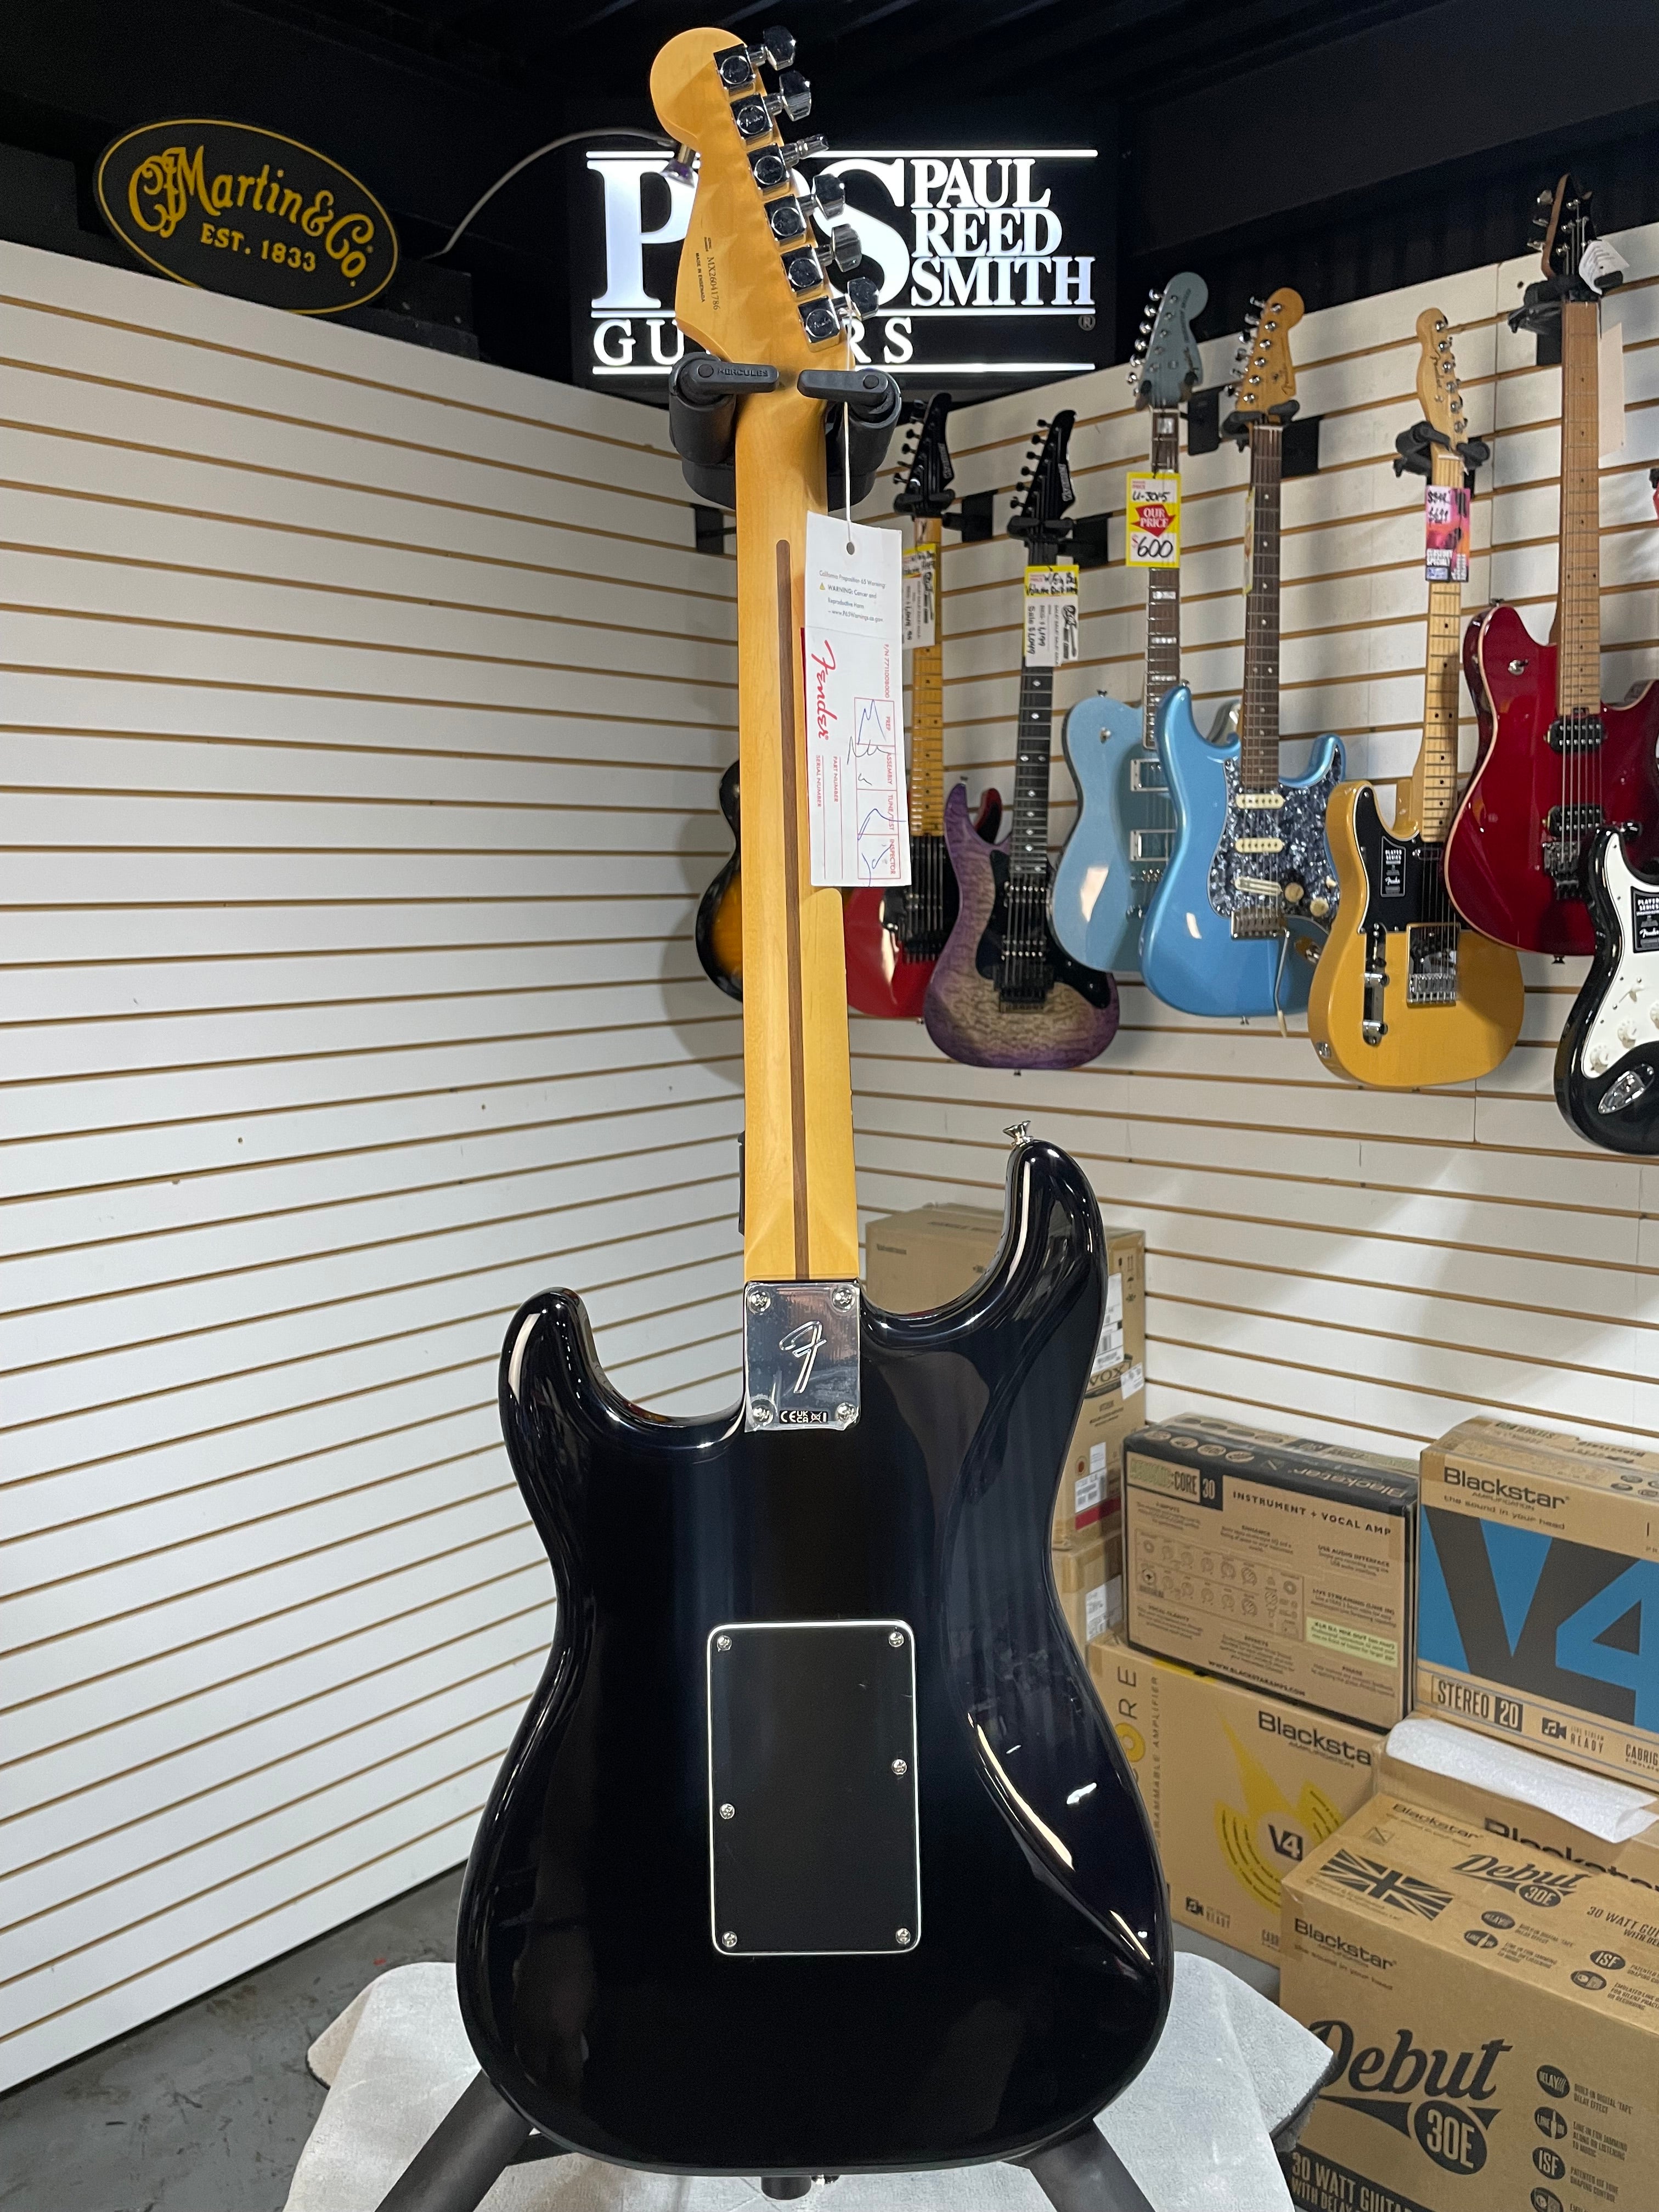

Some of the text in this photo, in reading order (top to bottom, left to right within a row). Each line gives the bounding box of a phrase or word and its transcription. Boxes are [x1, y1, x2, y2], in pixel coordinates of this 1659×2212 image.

[910, 158, 1052, 208] PAUL
[201, 222, 316, 272] EST. 1833
[586, 158, 911, 309] PS
[911, 207, 1063, 258] REED
[707, 256, 720, 311] MX26041786
[910, 257, 1096, 306] SMITH
[1140, 517, 1169, 528] PRICE
[1143, 508, 1165, 518] OUR
[1201, 1478, 1216, 1500] 30
[1444, 1466, 1566, 1509] Blackstar
[1465, 1499, 1496, 1514] sound
[1233, 1491, 1307, 1516] INSTRUMENT
[1321, 1512, 1361, 1529] VOCAL
[1365, 1523, 1392, 1536] AMP
[1437, 1680, 1519, 1728] STEREO 20
[1259, 1710, 1372, 1767] Blacksta
[1570, 1733, 1603, 1754] READY
[1392, 1803, 1479, 1838] Blackstar
[1268, 1824, 1304, 1862] V4
[1452, 1854, 1592, 1888] Debut
[1525, 1886, 1556, 1906] 30E
[1587, 1906, 1659, 1938] 30 WATT GUI
[1623, 1929, 1659, 1947] WITH DEL
[1295, 1917, 1393, 1970] Blackstar
[1595, 1951, 1621, 1968] ISF
[1641, 1997, 1659, 2009] PRACTI
[1309, 2020, 1513, 2101] Debut
[1427, 2108, 1475, 2169] 30E
[1292, 2151, 1311, 2181] 30
[1315, 2162, 1356, 2204] WATT
[1538, 2149, 1559, 2176] ISF
[1291, 2176, 1318, 2207] WITH
